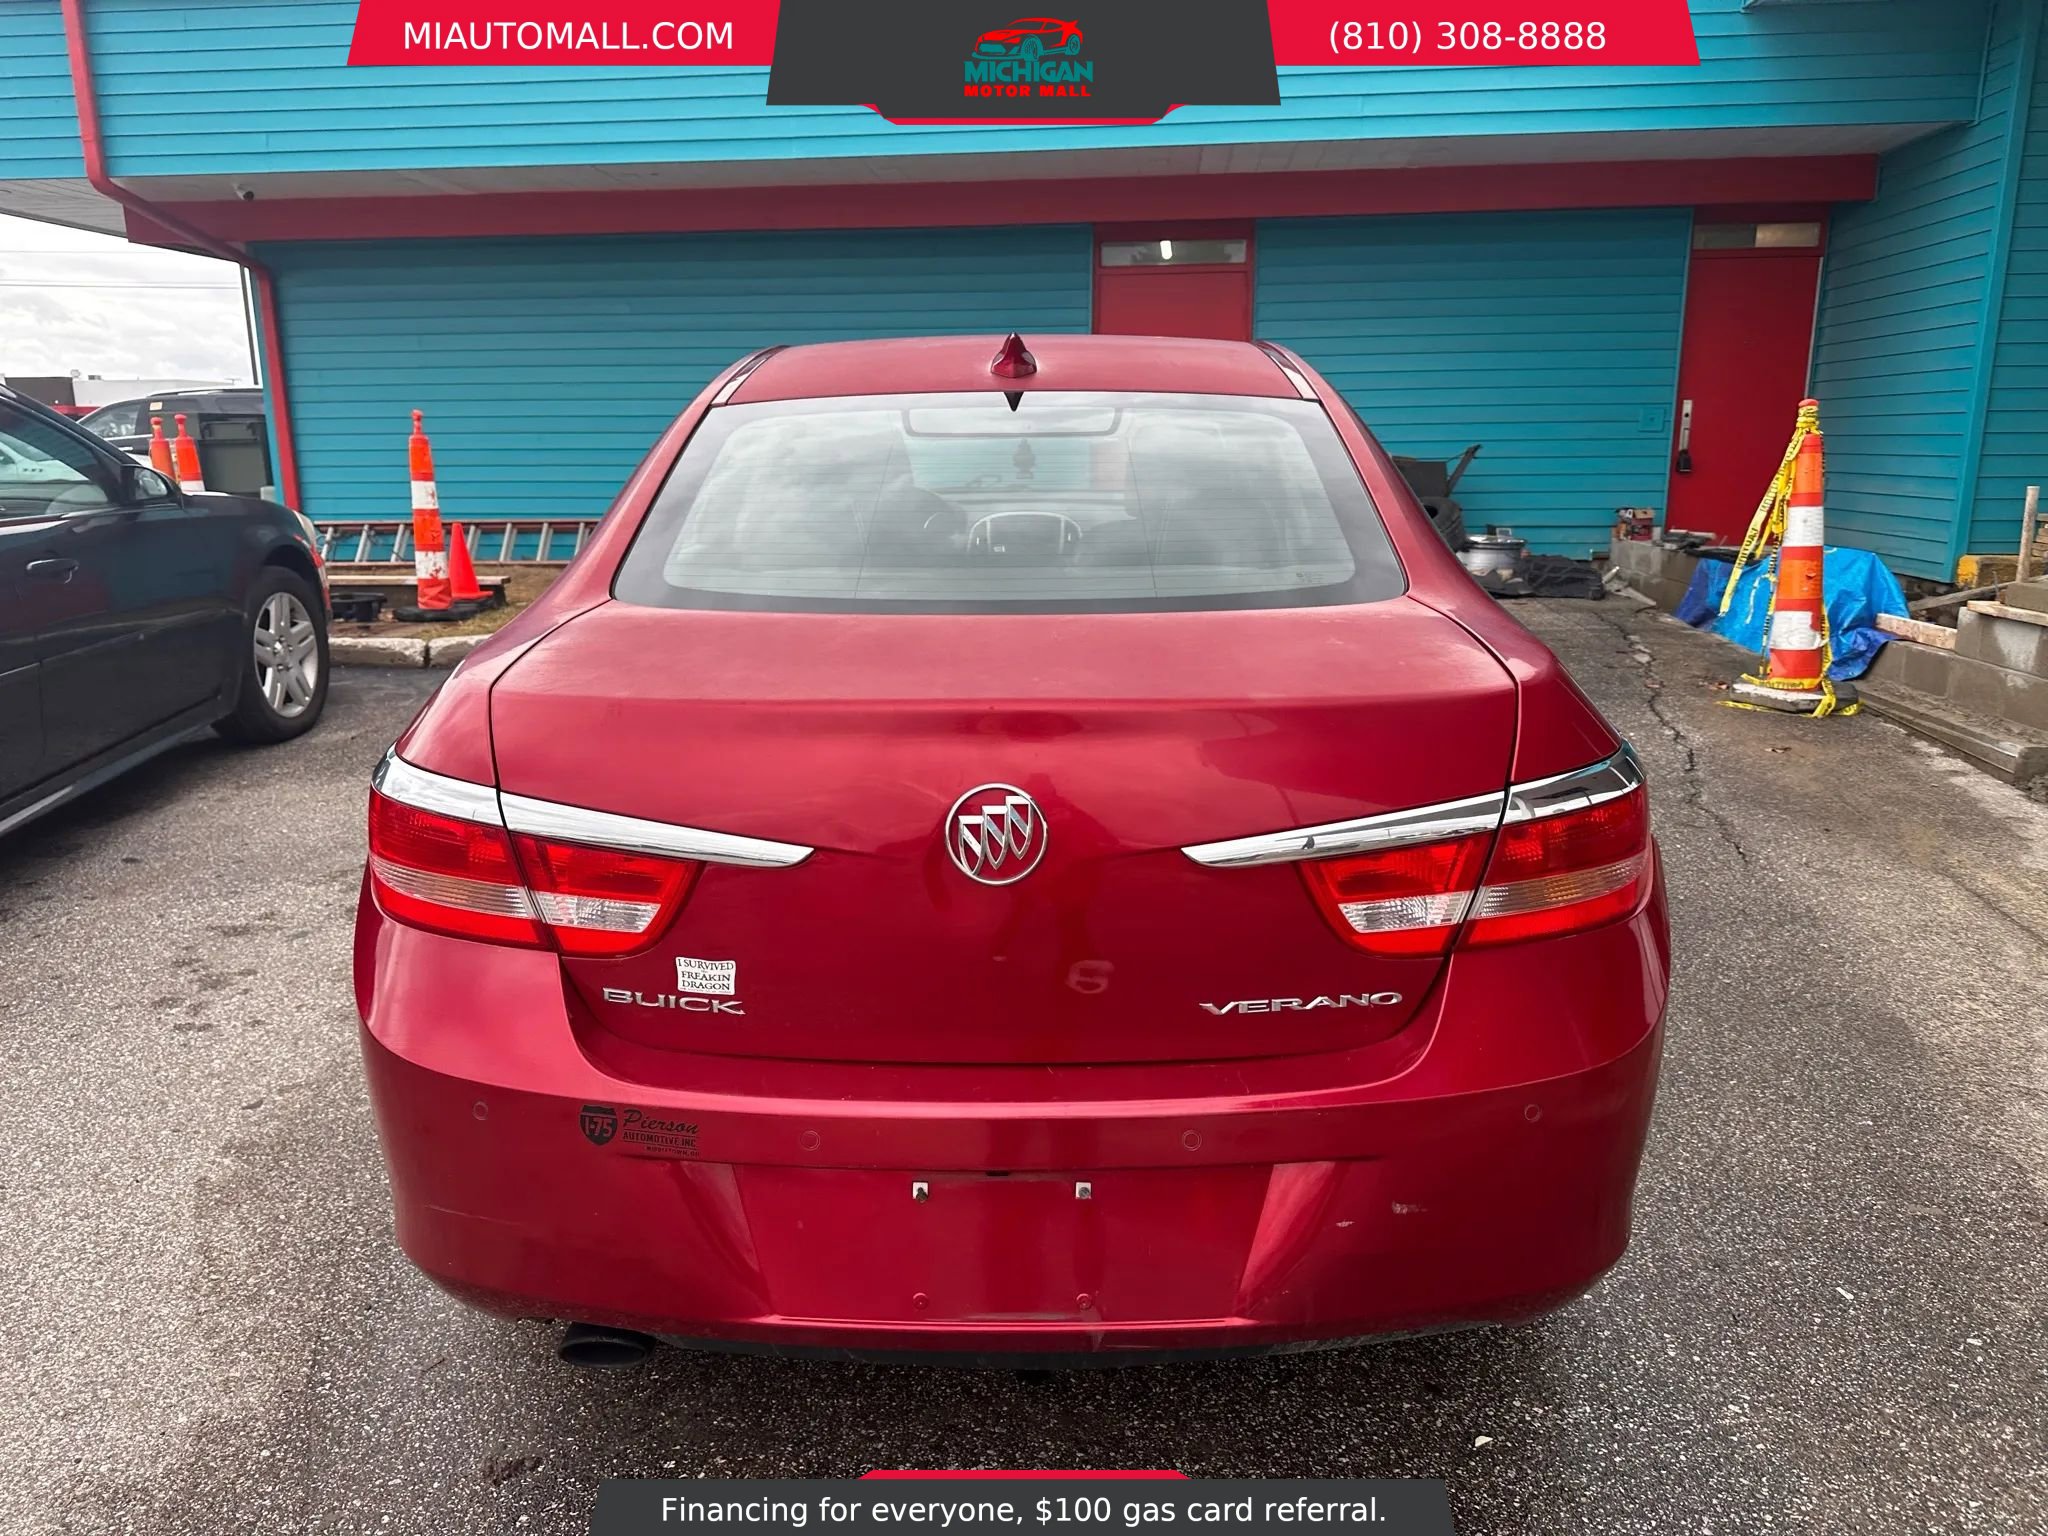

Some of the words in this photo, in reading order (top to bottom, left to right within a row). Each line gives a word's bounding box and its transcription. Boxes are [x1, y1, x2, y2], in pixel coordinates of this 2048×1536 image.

[678, 958, 682, 967] I
[683, 959, 734, 971] SURVIVED
[681, 970, 731, 982] FREAKIN
[682, 979, 730, 991] DRAGON
[602, 987, 746, 1015] BUICK
[1199, 991, 1403, 1016] VERANO
[623, 1109, 699, 1135] Pierson
[622, 1130, 680, 1146] AUTOMOTIVE
